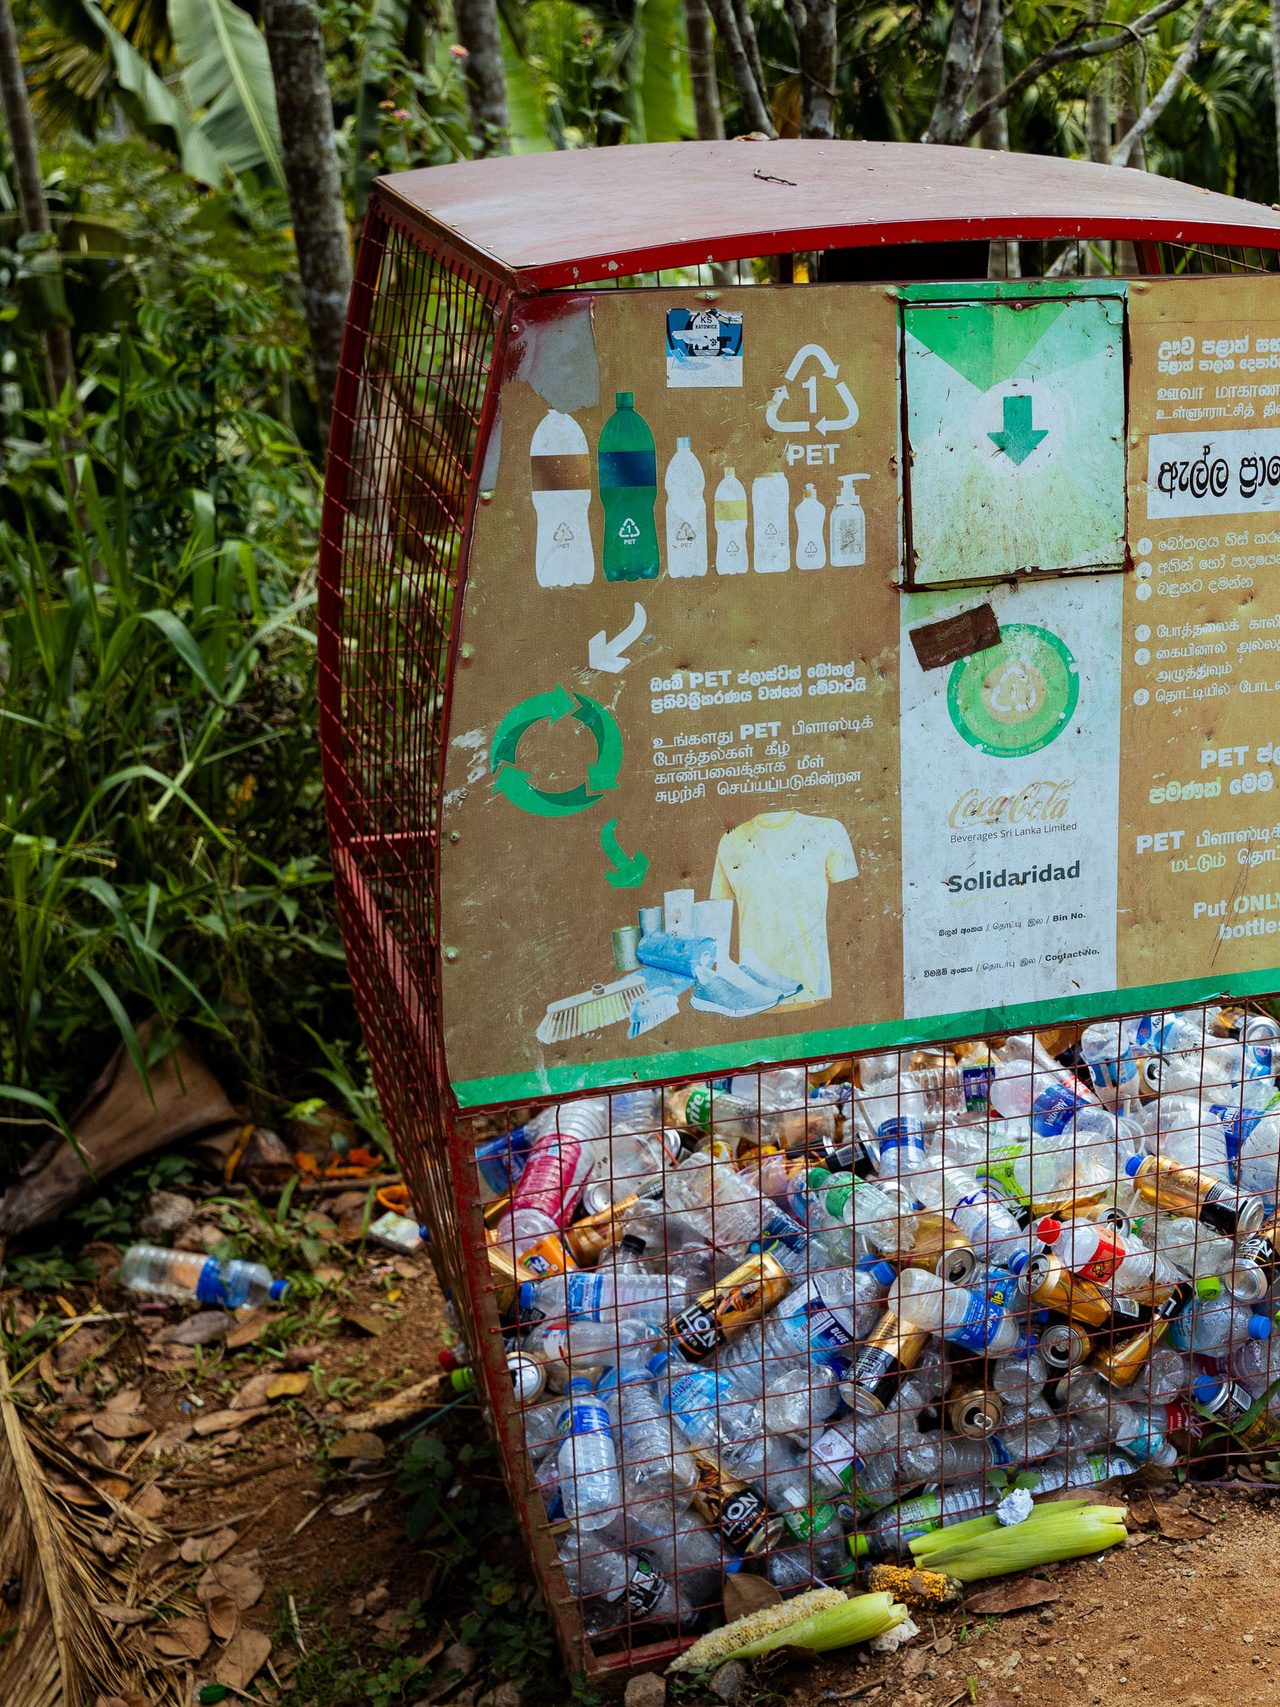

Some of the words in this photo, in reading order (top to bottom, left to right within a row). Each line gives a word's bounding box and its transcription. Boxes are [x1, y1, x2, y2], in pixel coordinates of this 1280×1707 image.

[1158, 336, 1195, 360] ඌව
[1202, 335, 1249, 358] පළාත්
[1158, 357, 1193, 375] පළාත්
[1199, 358, 1235, 373] පාලන
[1157, 386, 1204, 400] ஊவா
[786, 443, 840, 466] PET
[1157, 445, 1229, 499] ඇල්ල
[1158, 535, 1219, 551] බෝතලය
[1225, 531, 1249, 547] හිස්
[1157, 557, 1193, 575] අතින්
[1199, 554, 1226, 570] හෝ
[1208, 575, 1253, 594] දමන්න
[1156, 619, 1240, 640] போத்தலைக்
[1156, 640, 1228, 660] கையினால்
[690, 670, 732, 689] PET
[1155, 682, 1231, 704] தொட்டியில்
[652, 730, 733, 749] உங்களது
[740, 721, 782, 741] PET
[792, 714, 874, 736] பிளாஸ்டிக்
[653, 745, 753, 768] போத்தல்கள்
[765, 740, 791, 758] கீழ்
[797, 754, 825, 770] மீள்
[1201, 746, 1249, 769] PET
[655, 783, 706, 804] சுழற்சி
[1229, 773, 1273, 795] මෙම
[948, 779, 1079, 830] Coca-Cola
[950, 830, 998, 843] Beverages
[1000, 829, 1012, 838] Sri
[1014, 826, 1041, 837] Lanka
[1044, 822, 1077, 834] Limited
[1136, 830, 1185, 854] PET
[1171, 851, 1227, 873] மட்டும்
[948, 860, 1081, 893] Solidaridad
[1052, 913, 1068, 922] Bin
[1070, 912, 1086, 921] No.
[1194, 900, 1227, 919] Put
[1045, 950, 1083, 962] Contact
[1084, 948, 1100, 956] No.
[679, 1324, 698, 1347] LAER
[830, 1327, 850, 1344] BLUE
